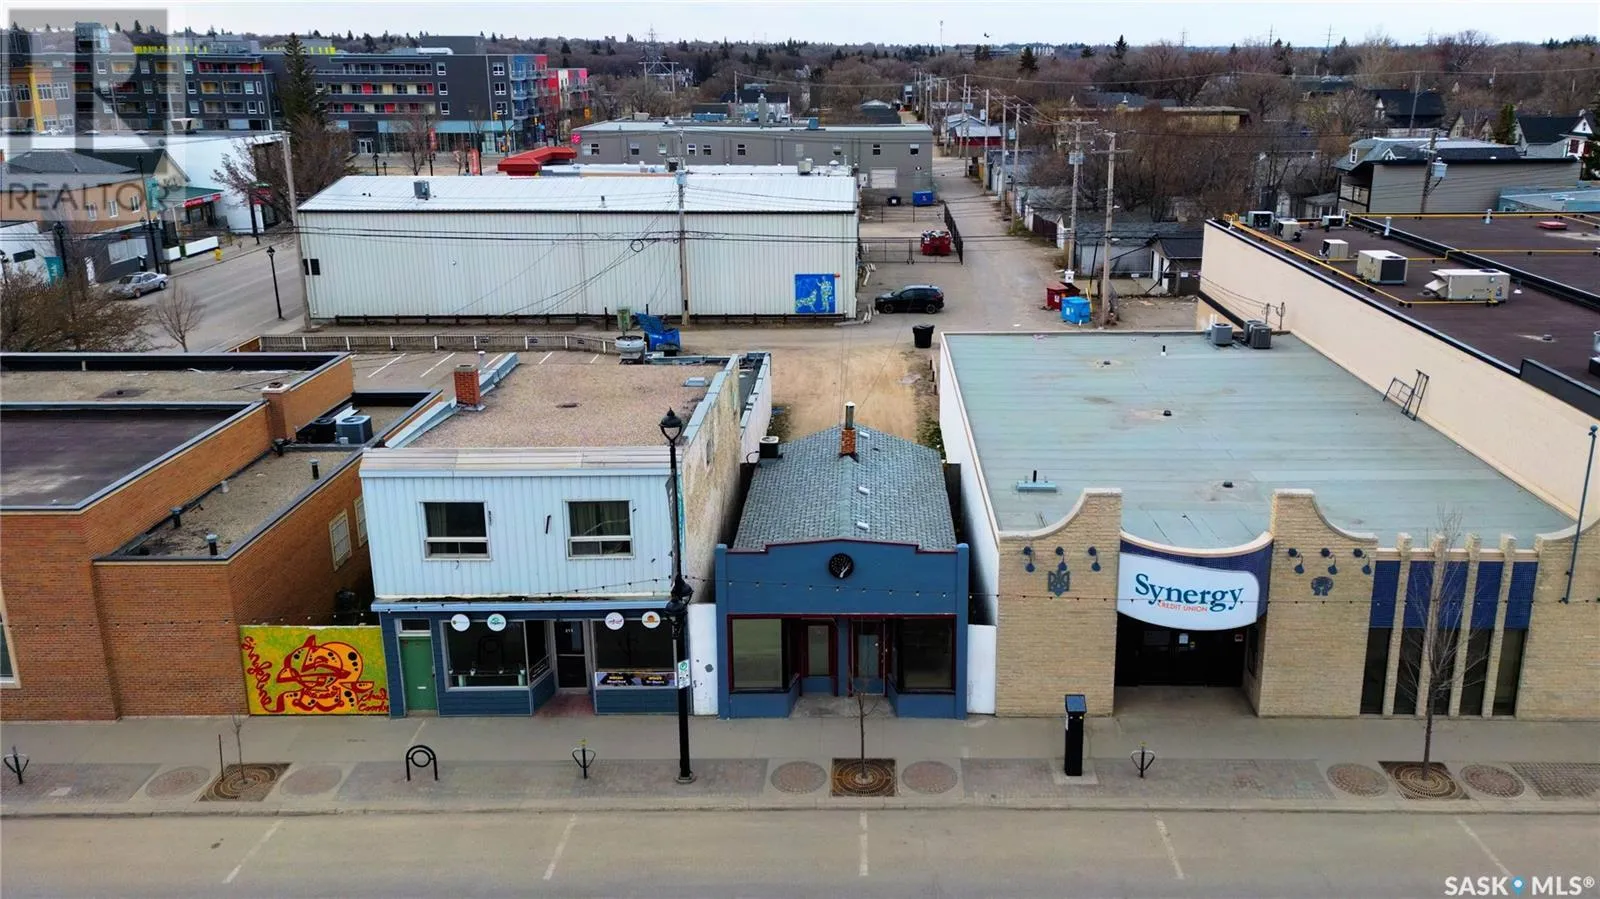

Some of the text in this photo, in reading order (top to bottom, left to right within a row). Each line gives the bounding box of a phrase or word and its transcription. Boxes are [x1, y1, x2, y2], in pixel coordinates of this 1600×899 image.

[1135, 573, 1244, 612] Synergy
[1157, 602, 1207, 613] CREDIT UNION
